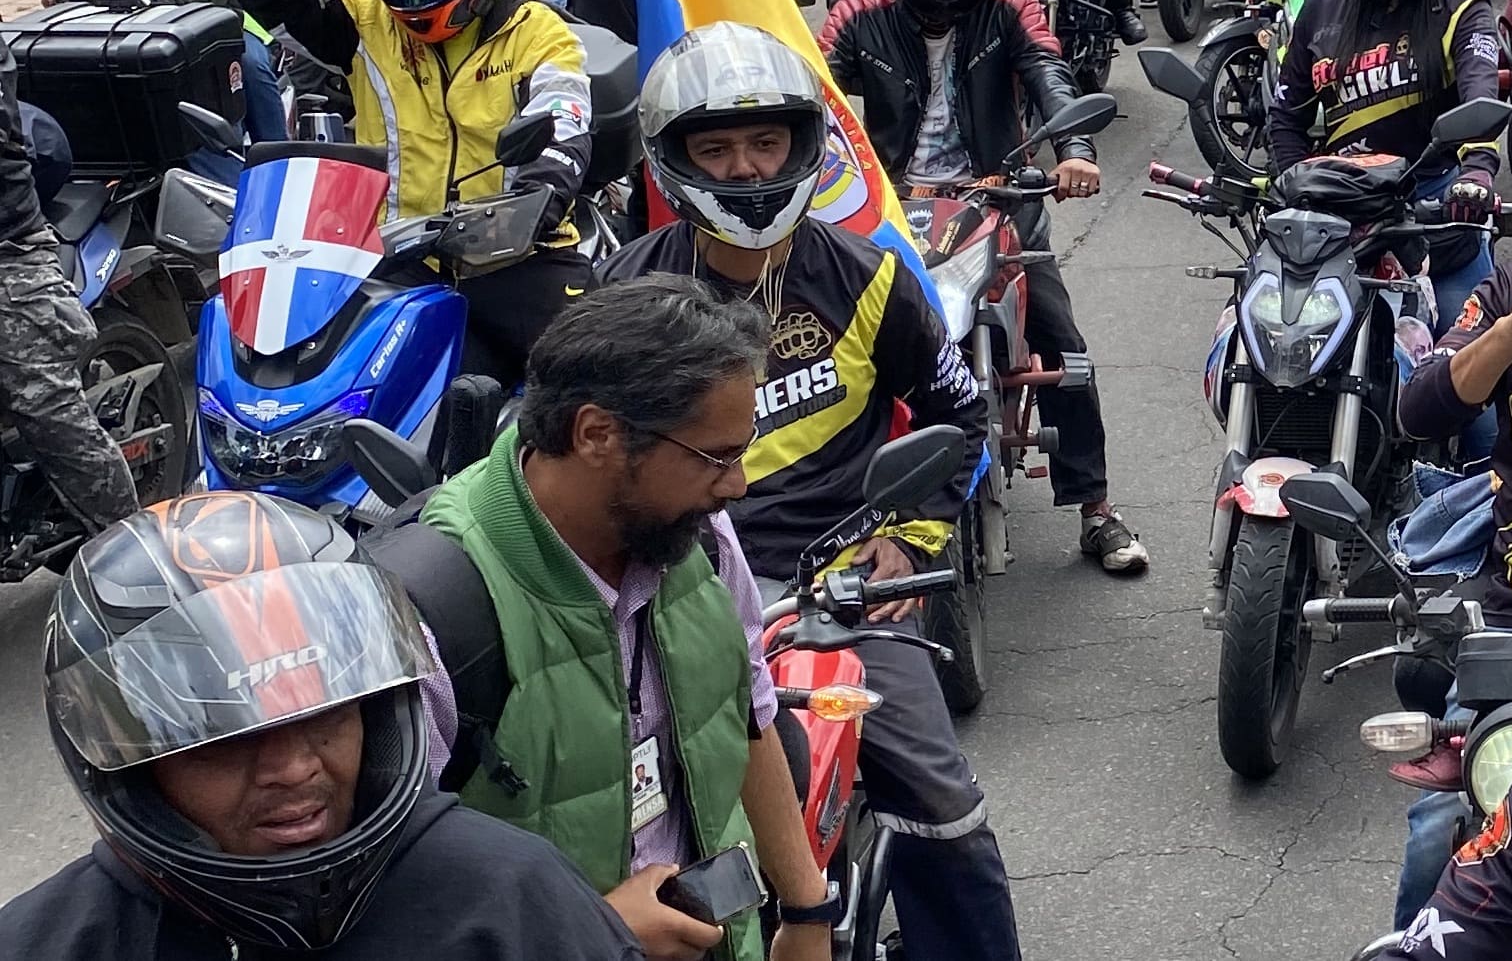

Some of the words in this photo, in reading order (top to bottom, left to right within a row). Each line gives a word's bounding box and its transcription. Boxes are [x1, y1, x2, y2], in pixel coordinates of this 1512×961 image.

[481, 59, 514, 82] YAMAH
[369, 334, 400, 379] Carlos
[755, 357, 838, 422] HERS
[632, 744, 652, 763] PTLY
